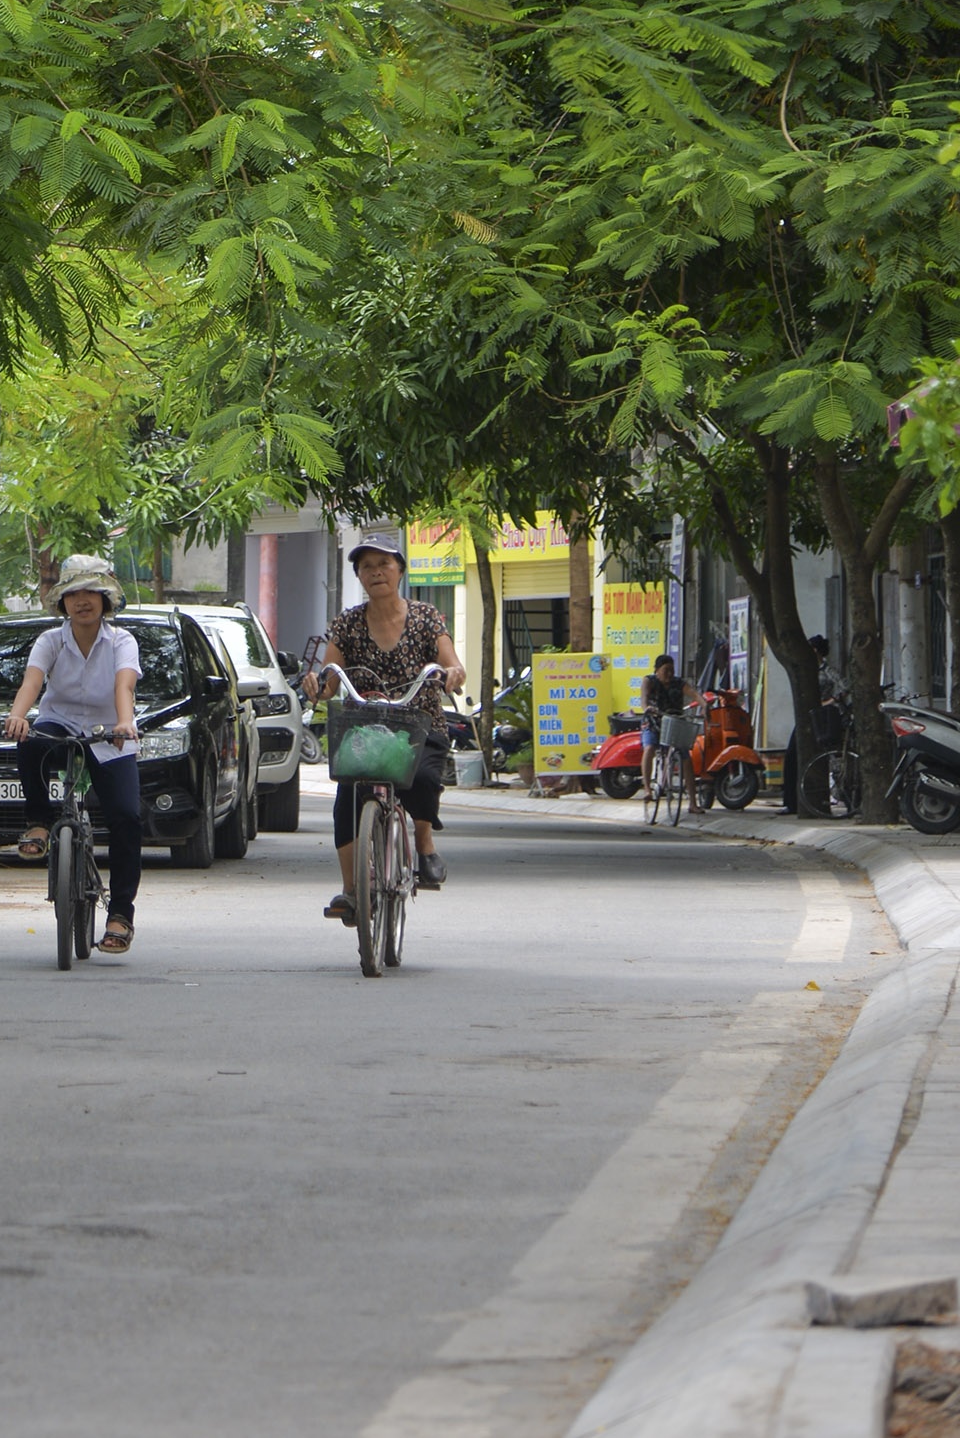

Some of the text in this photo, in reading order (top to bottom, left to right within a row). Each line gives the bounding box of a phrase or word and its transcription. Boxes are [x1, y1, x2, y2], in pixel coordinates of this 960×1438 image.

[606, 626, 660, 645] Fresh chicken
[550, 683, 597, 699] MÌ XÀO
